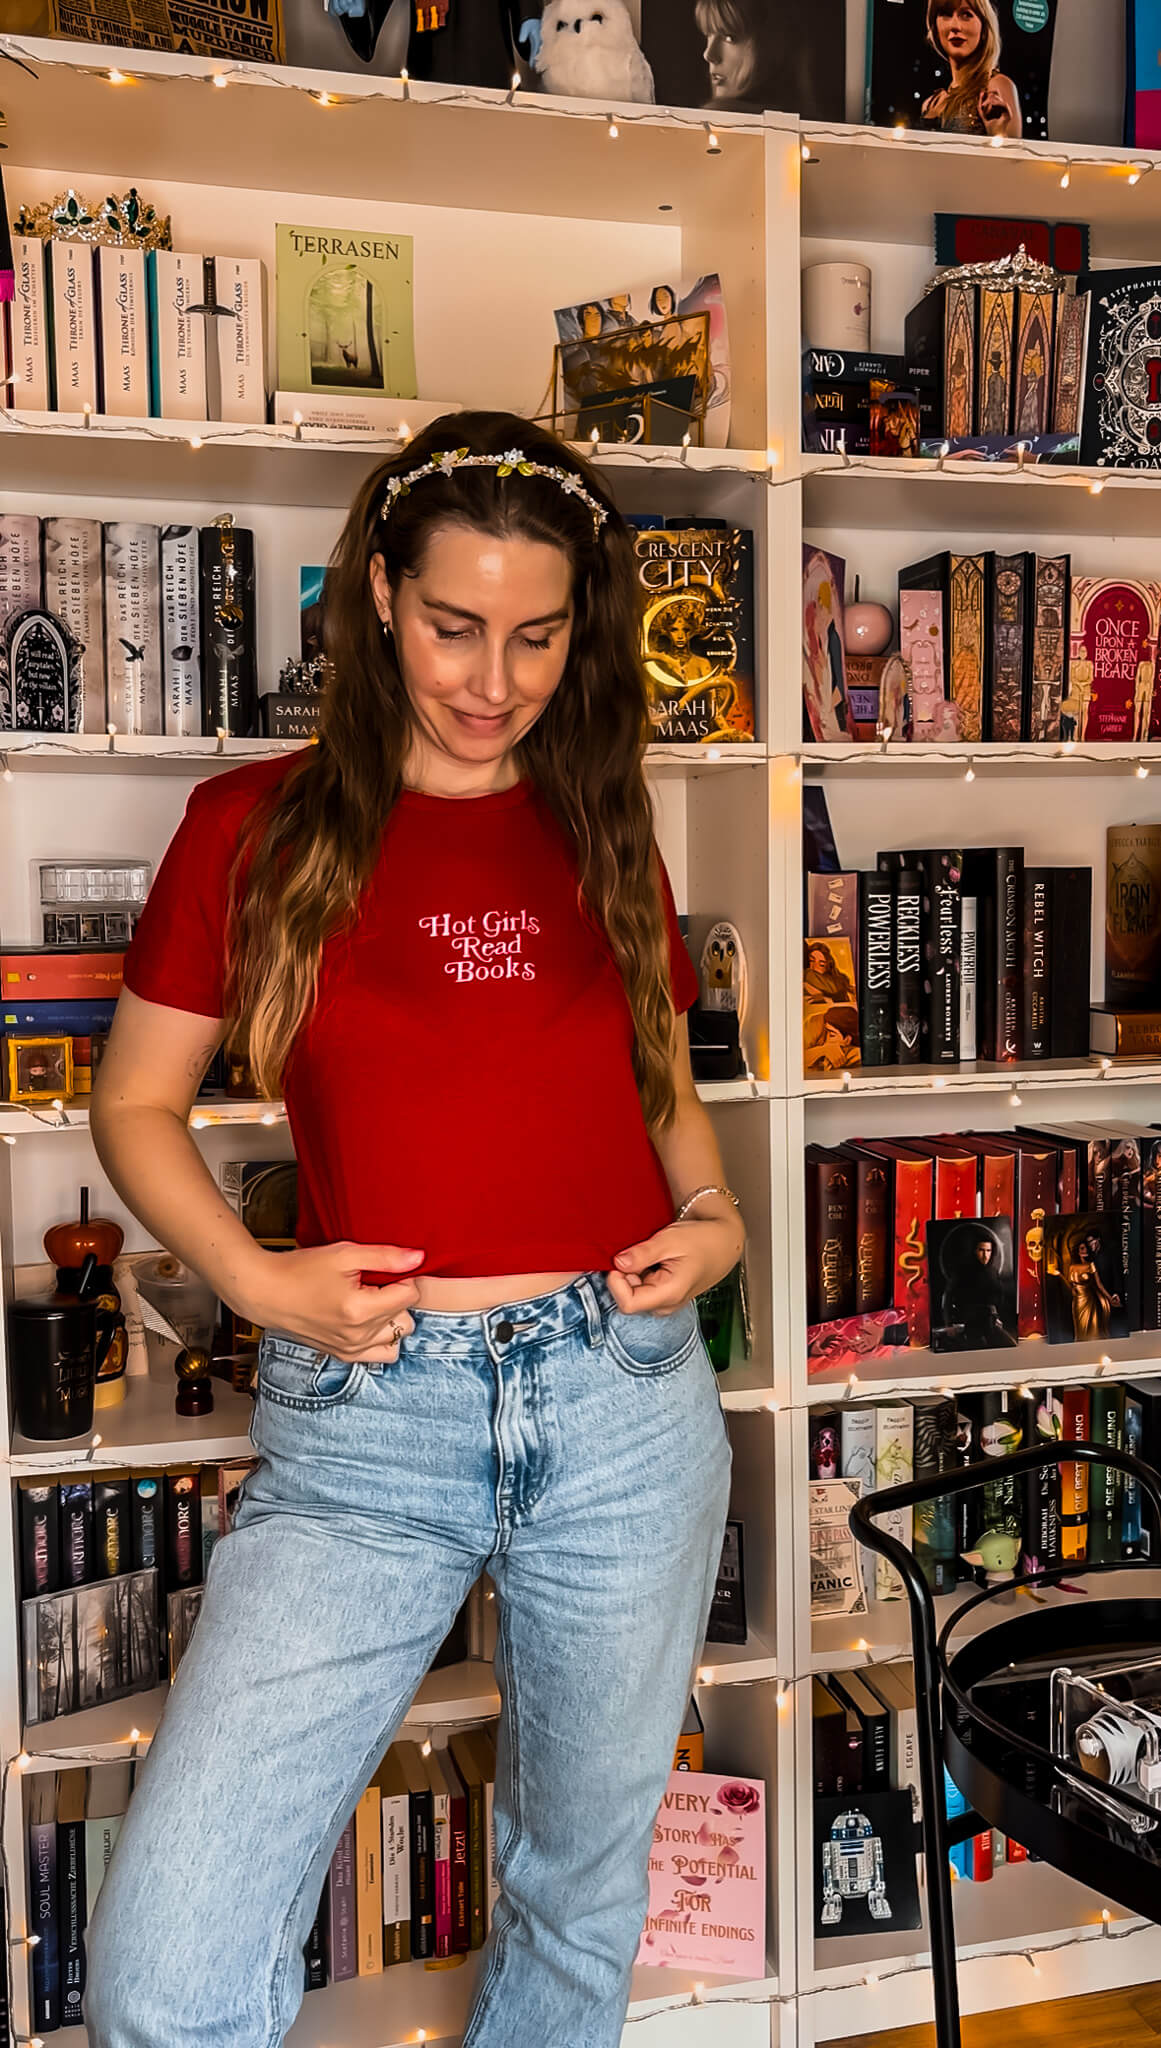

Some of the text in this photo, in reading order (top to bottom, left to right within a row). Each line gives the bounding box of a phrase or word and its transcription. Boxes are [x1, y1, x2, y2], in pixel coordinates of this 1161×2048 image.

[222, 25, 274, 52] FAMILY
[289, 233, 399, 260] TERRASEN
[21, 261, 31, 294] GLASS
[66, 267, 77, 299] GLASS
[119, 272, 129, 303] GLASS
[175, 276, 185, 307] GLASS
[24, 304, 32, 346] THRONE
[69, 308, 78, 351] THRONE
[121, 313, 130, 355] THRONE
[177, 317, 186, 359] THRONE
[233, 282, 245, 364] THRONE GLASS
[25, 356, 34, 384] MAAS
[71, 361, 79, 388] MAAS
[123, 365, 131, 392] MAAS
[178, 368, 188, 395] MAAS
[236, 373, 246, 400] MAAS
[128, 540, 139, 570] HÖFE
[176, 542, 188, 573] HÖFE
[635, 541, 726, 559] CRESCENT
[57, 558, 67, 596] REICH
[212, 564, 222, 600] REICH
[639, 559, 721, 588] CITY
[71, 570, 81, 615] SIEBEN
[117, 562, 128, 622] DAS REICH
[130, 575, 141, 621] SIEBEN
[166, 564, 176, 623] DAS REICH
[177, 576, 188, 621] SIEBEN
[1095, 617, 1140, 638] ONCE
[1095, 636, 1125, 649] UPON
[1094, 662, 1137, 681] HEART
[1095, 647, 1139, 665] BROKEN
[173, 675, 182, 715] SARAH
[184, 673, 193, 706] MAAS
[231, 674, 240, 708] MAAS
[275, 705, 321, 717] SARAH
[656, 720, 710, 738] MAAS
[1005, 874, 1017, 928] CRIMSON
[1115, 881, 1151, 910] IRON
[418, 909, 540, 938] Hot Girls
[896, 894, 921, 974] RECKLESS
[1033, 883, 1045, 979] REBEL WITCH
[451, 933, 522, 962] Read
[867, 893, 892, 990] POWERLESS
[1005, 930, 1017, 969] MOTH
[444, 956, 535, 983] Books
[1105, 1486, 1115, 1507] DIE
[1041, 1507, 1049, 1550] DEBORAH
[1048, 1499, 1057, 1558] HARKNESS
[905, 1732, 915, 1769] ESCAPE
[660, 1792, 711, 1813] VERY
[38, 1834, 50, 1882] MASTER
[671, 1854, 758, 1881] POTENTIAL
[40, 1884, 51, 1920] SOUL
[457, 1881, 465, 1928] Eckhart Tolle
[671, 1888, 712, 1913] FOR
[643, 1916, 756, 1942] INFINITE ENDINGS
